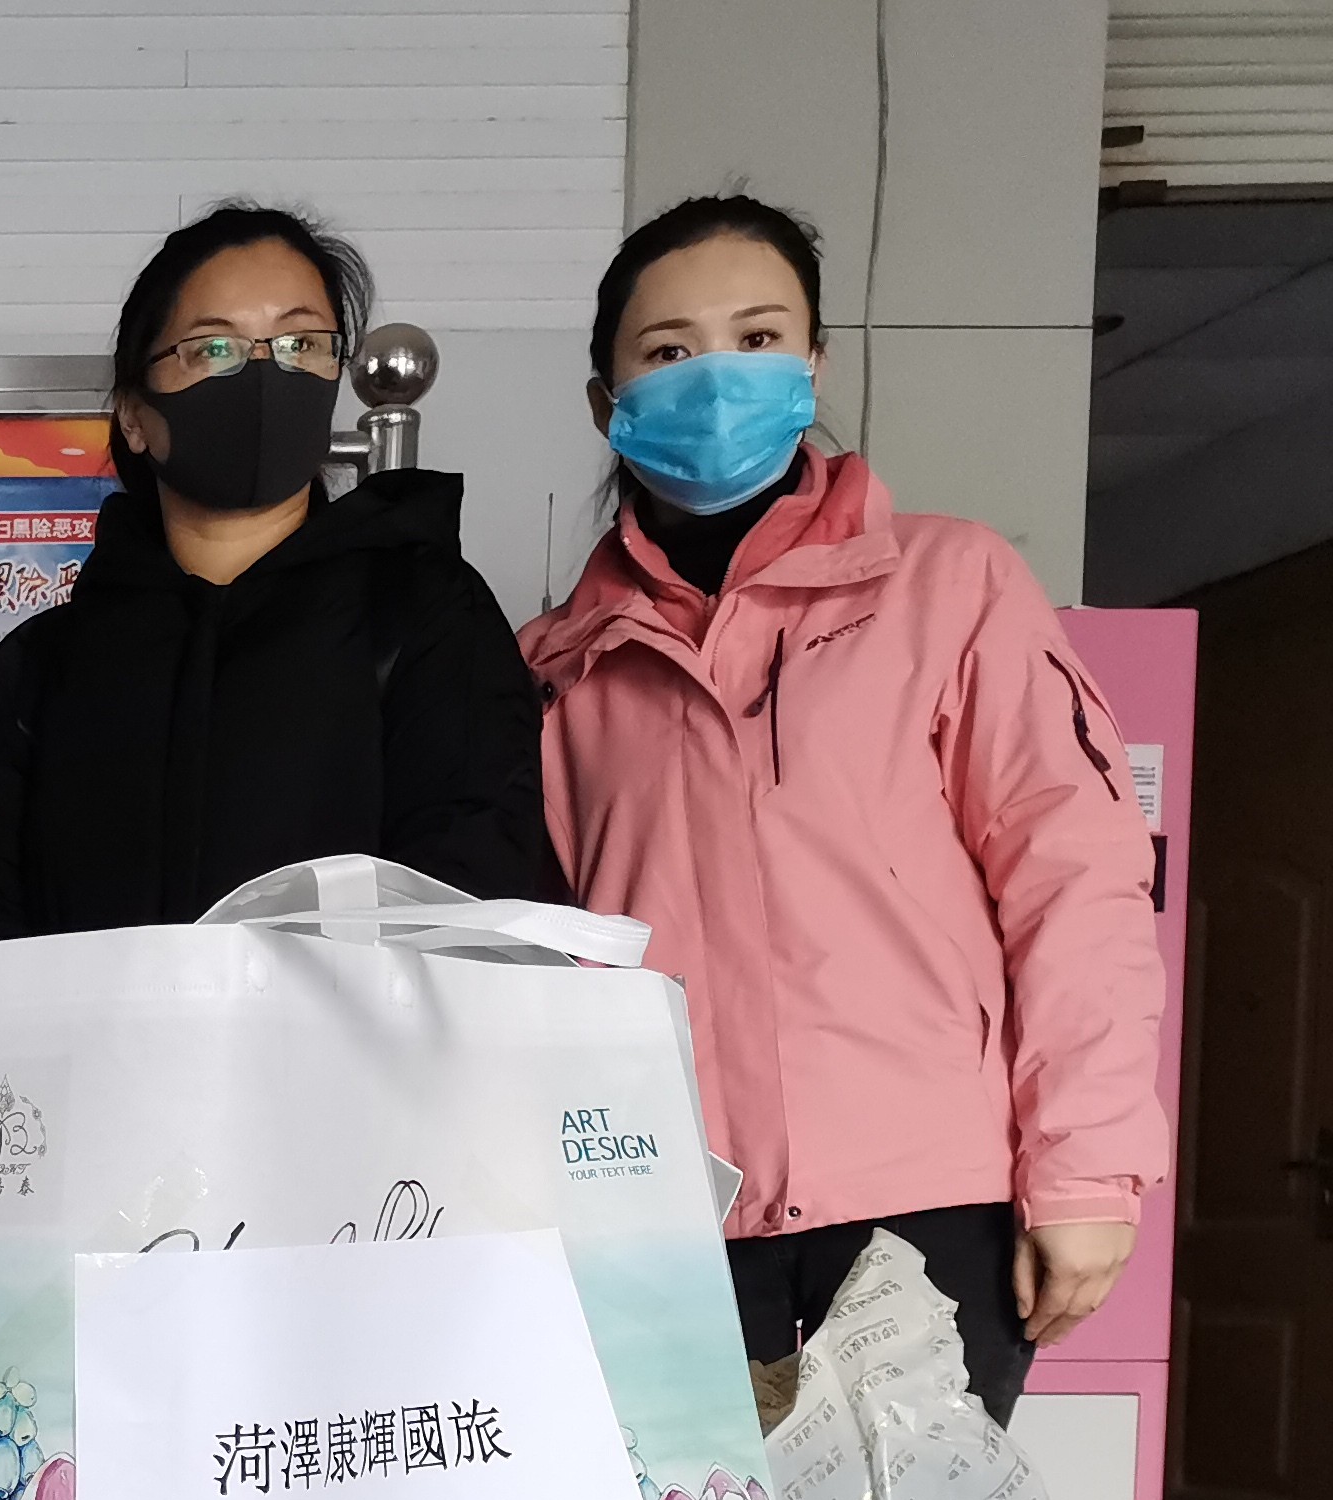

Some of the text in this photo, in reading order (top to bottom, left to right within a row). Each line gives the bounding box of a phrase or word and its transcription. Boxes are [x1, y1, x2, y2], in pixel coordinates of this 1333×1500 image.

[562, 1108, 610, 1134] ART
[562, 1134, 659, 1163] DESIGN
[569, 1165, 653, 1181] YOUR TEXT HERE
[213, 1398, 514, 1497] 菏澤康輝國旅
